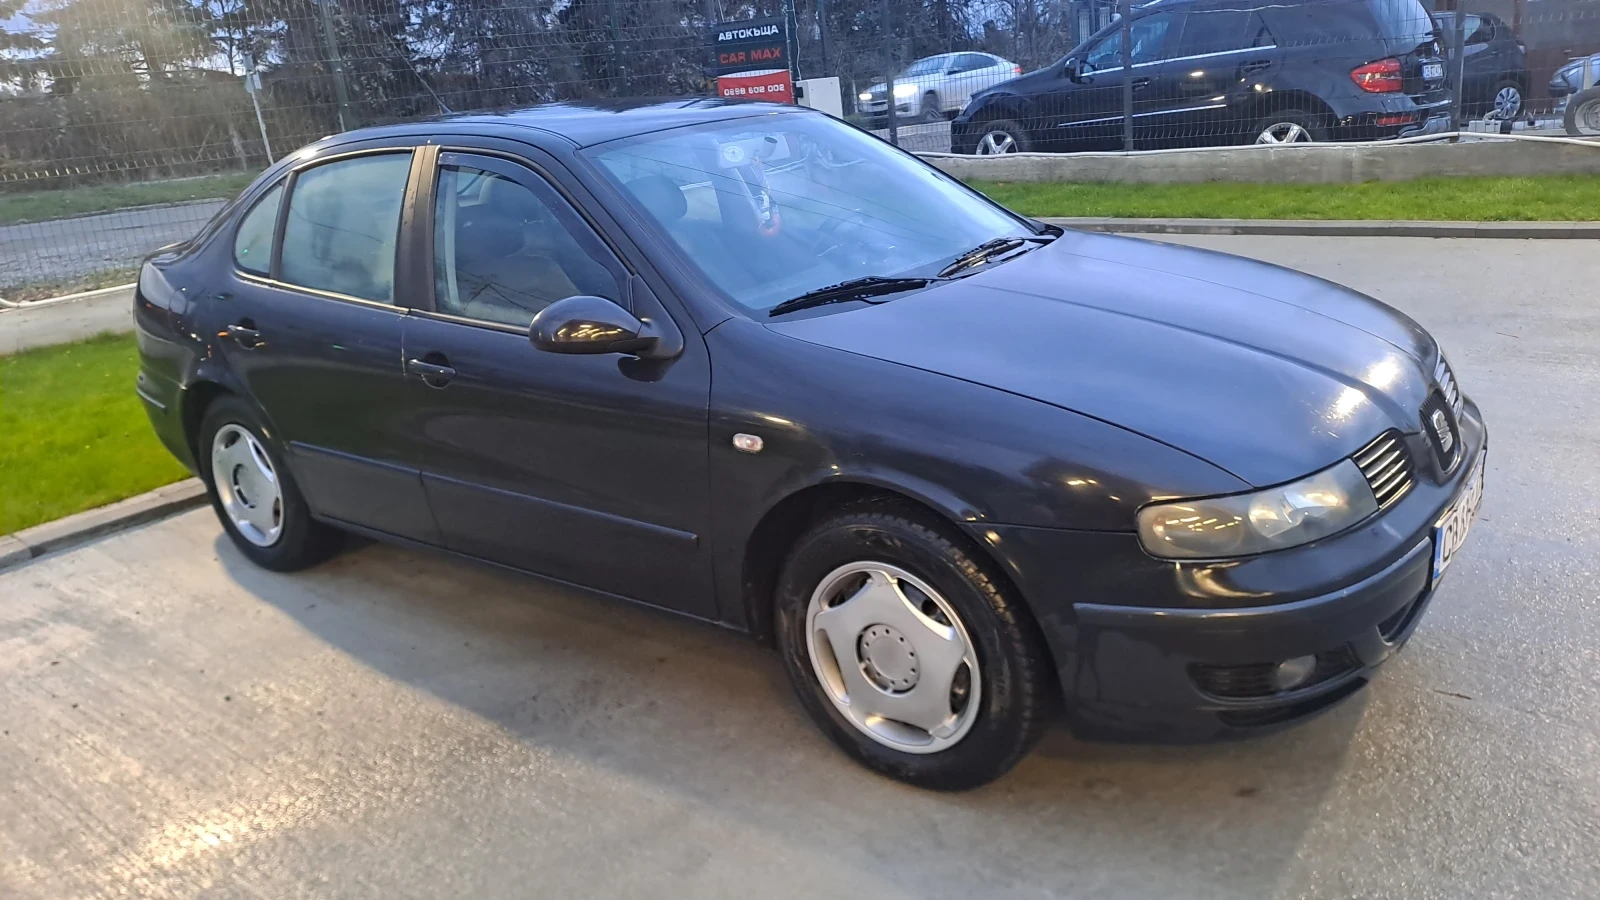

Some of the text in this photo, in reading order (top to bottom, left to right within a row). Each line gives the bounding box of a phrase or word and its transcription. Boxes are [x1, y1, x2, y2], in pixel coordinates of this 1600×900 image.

[718, 25, 779, 41] АВТОКЪЩА
[720, 48, 781, 64] CAR MAX
[748, 86, 765, 94] 602
[767, 84, 785, 92] 002
